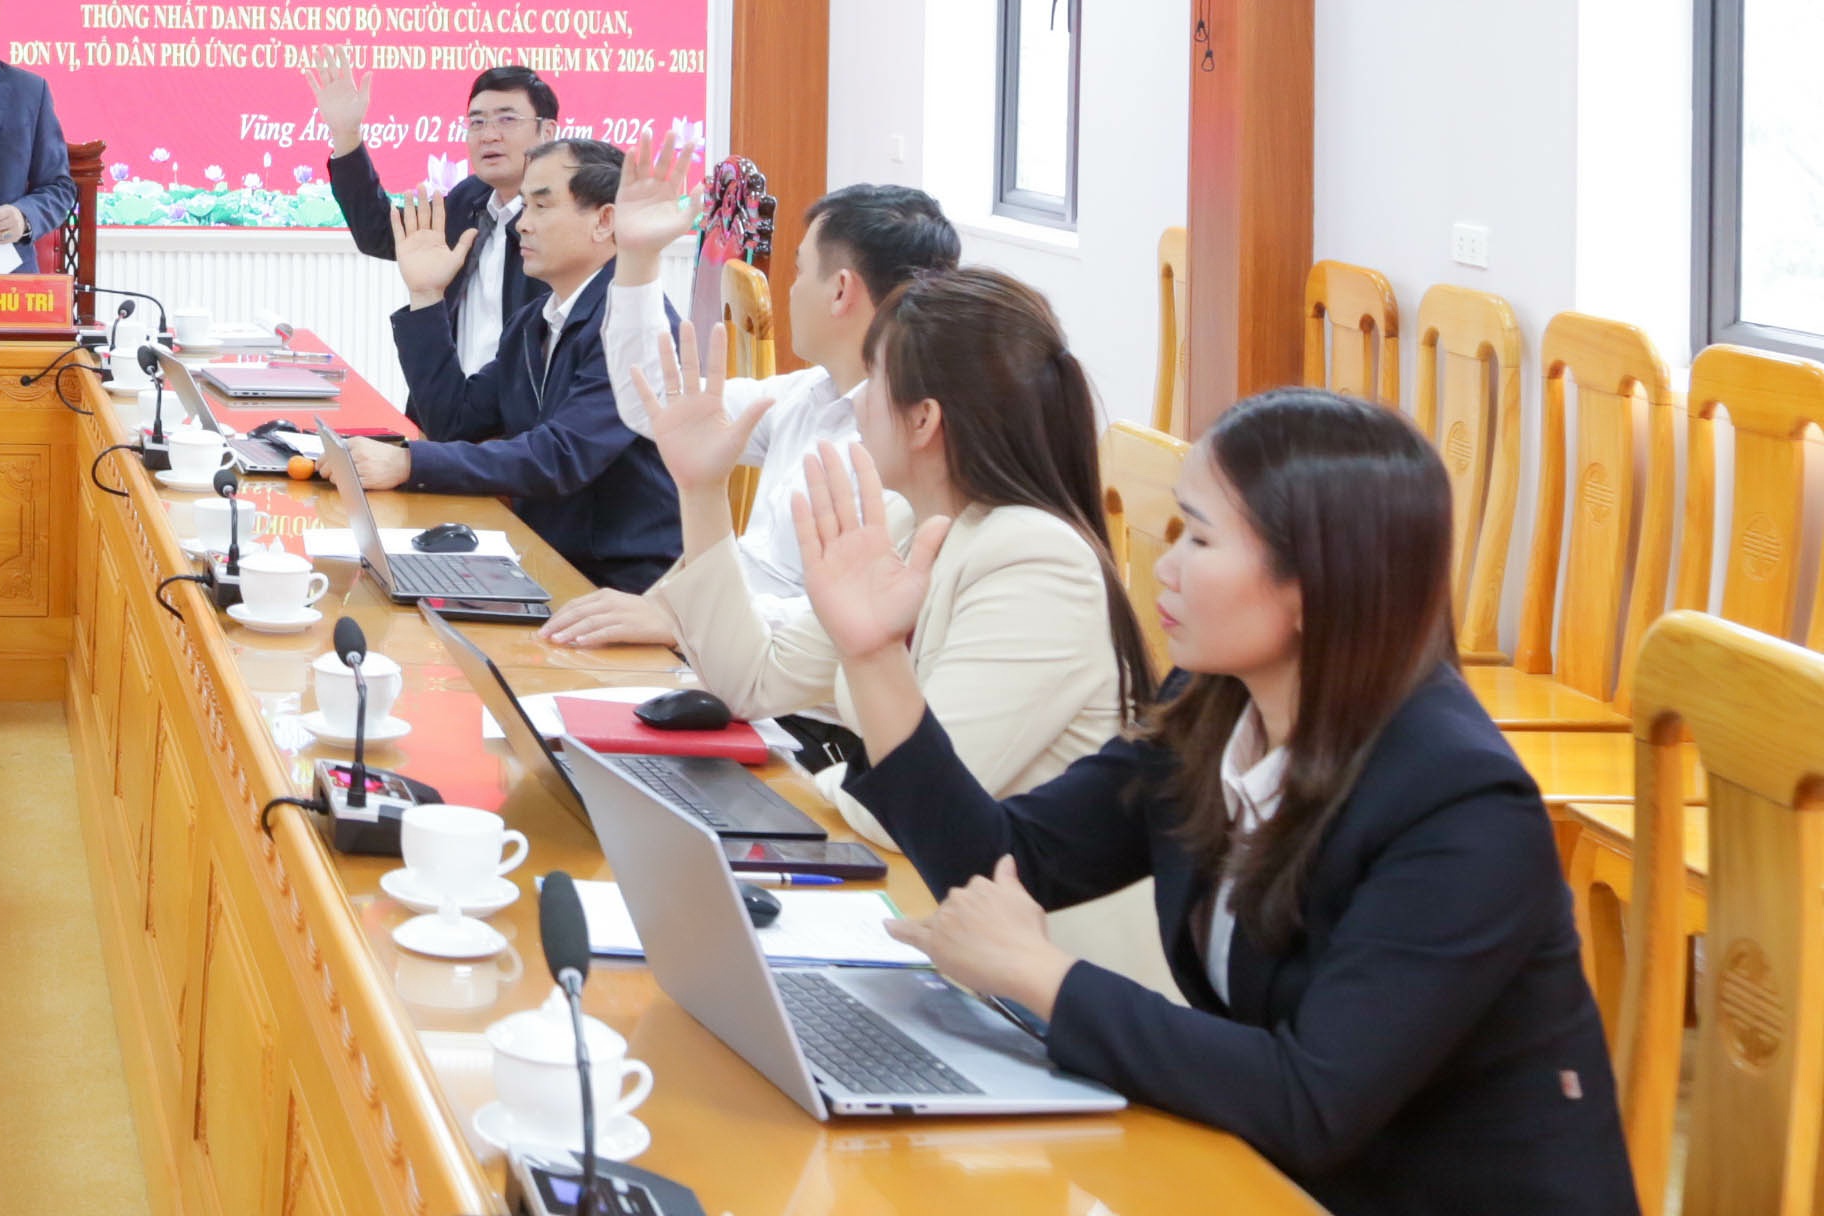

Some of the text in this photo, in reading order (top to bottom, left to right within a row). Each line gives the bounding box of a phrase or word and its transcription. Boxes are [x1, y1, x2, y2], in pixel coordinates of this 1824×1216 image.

[211, 6, 266, 30] DANH
[270, 0, 322, 31] SÁCH
[325, 5, 352, 31] SƠ
[356, 4, 382, 37] BỘ
[386, 2, 450, 33] NGƯỜI
[454, 2, 495, 33] CỦA
[497, 2, 538, 34] CÁC
[541, 9, 571, 34] CƠ
[573, 10, 633, 39] QUAN,
[9, 40, 52, 66] ĐƠN
[56, 41, 81, 72] VỊ,
[85, 36, 112, 67] TỔ
[116, 36, 157, 67] DÂN
[161, 36, 201, 68] PHỐ
[205, 36, 248, 68] ỨNG
[251, 37, 282, 68] CỬ
[372, 45, 426, 70] HĐND
[431, 40, 513, 70] PHƯỜNG
[517, 43, 581, 78] NHIỆM
[585, 41, 614, 72] KỲ
[617, 48, 655, 73] 2026
[669, 48, 705, 73] 2031
[240, 113, 296, 148] Vũng
[415, 115, 442, 143] 02
[26, 289, 54, 313] TRÌ
